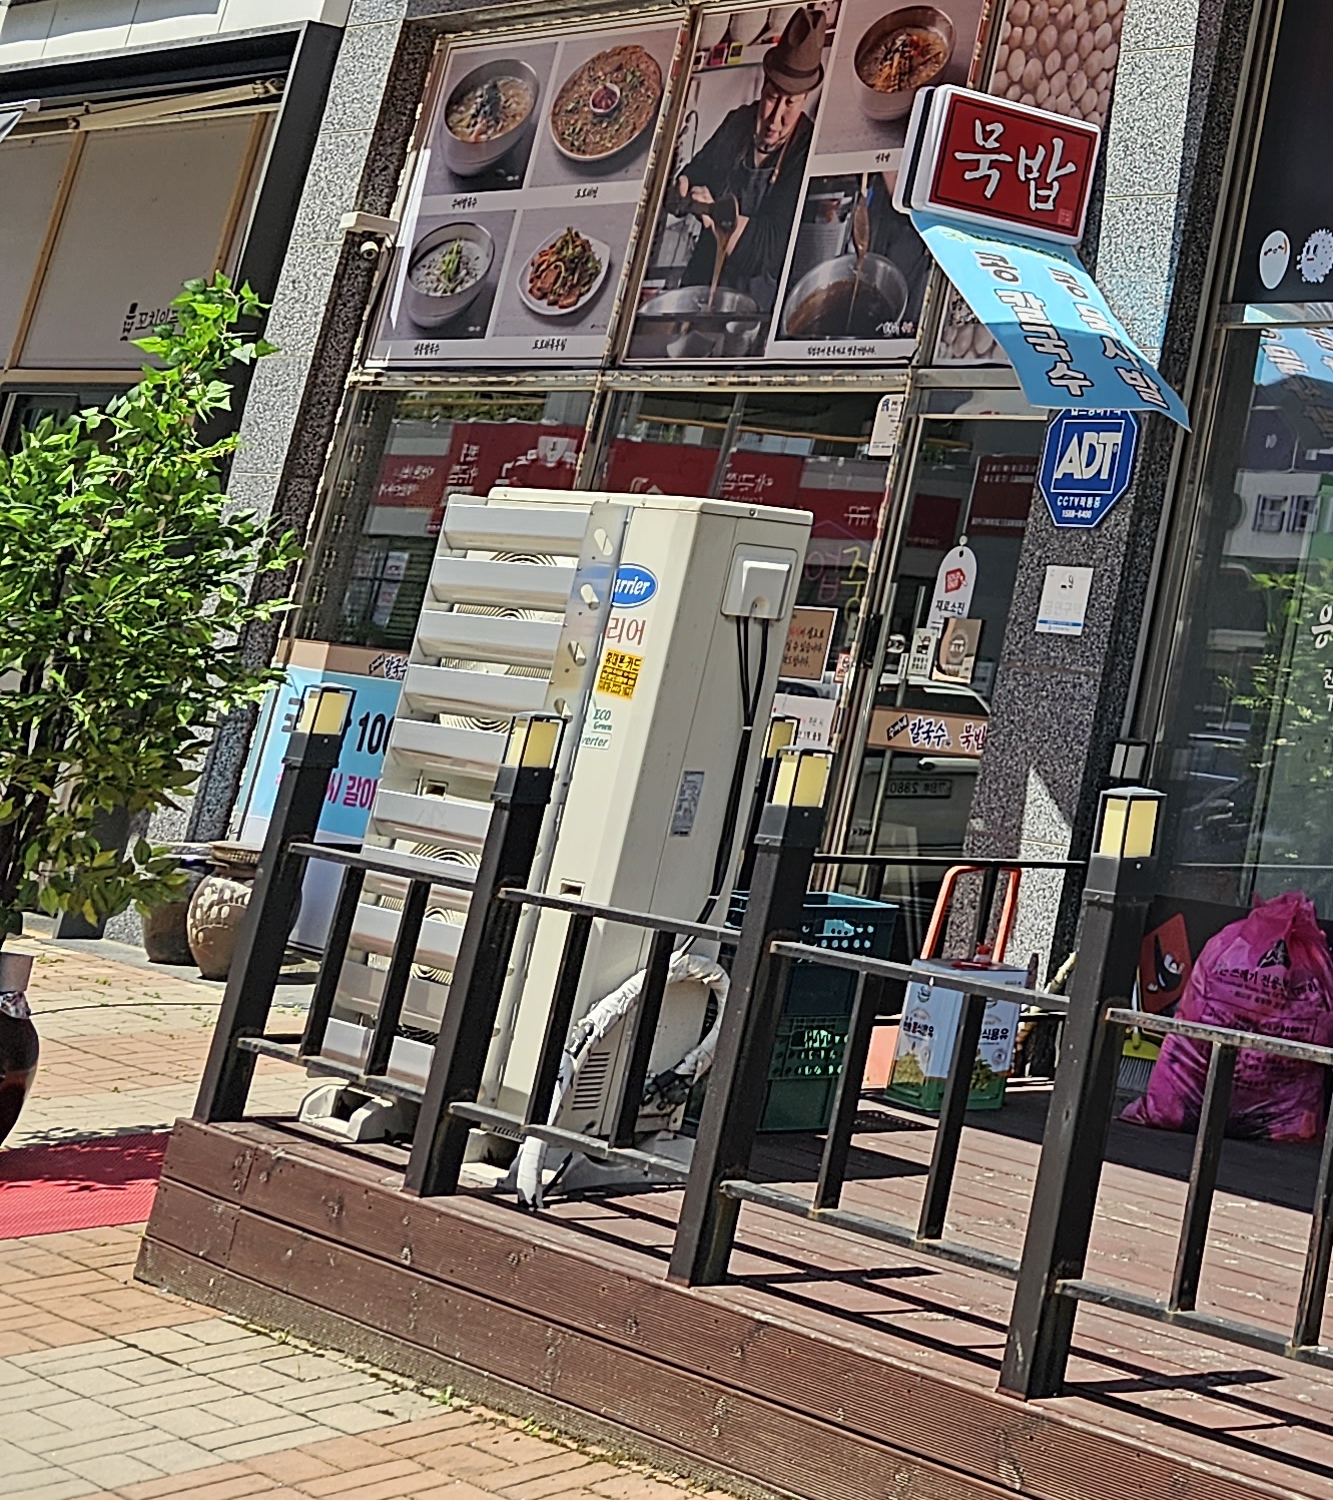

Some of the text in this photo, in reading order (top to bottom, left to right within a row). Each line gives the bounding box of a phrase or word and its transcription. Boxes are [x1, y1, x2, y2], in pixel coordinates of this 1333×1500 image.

[953, 117, 1078, 213] 묵밥
[994, 288, 1096, 398] 칼국수
[1055, 431, 1123, 481] ADT
[605, 617, 647, 646] 리어
[909, 716, 948, 748] 칼국수
